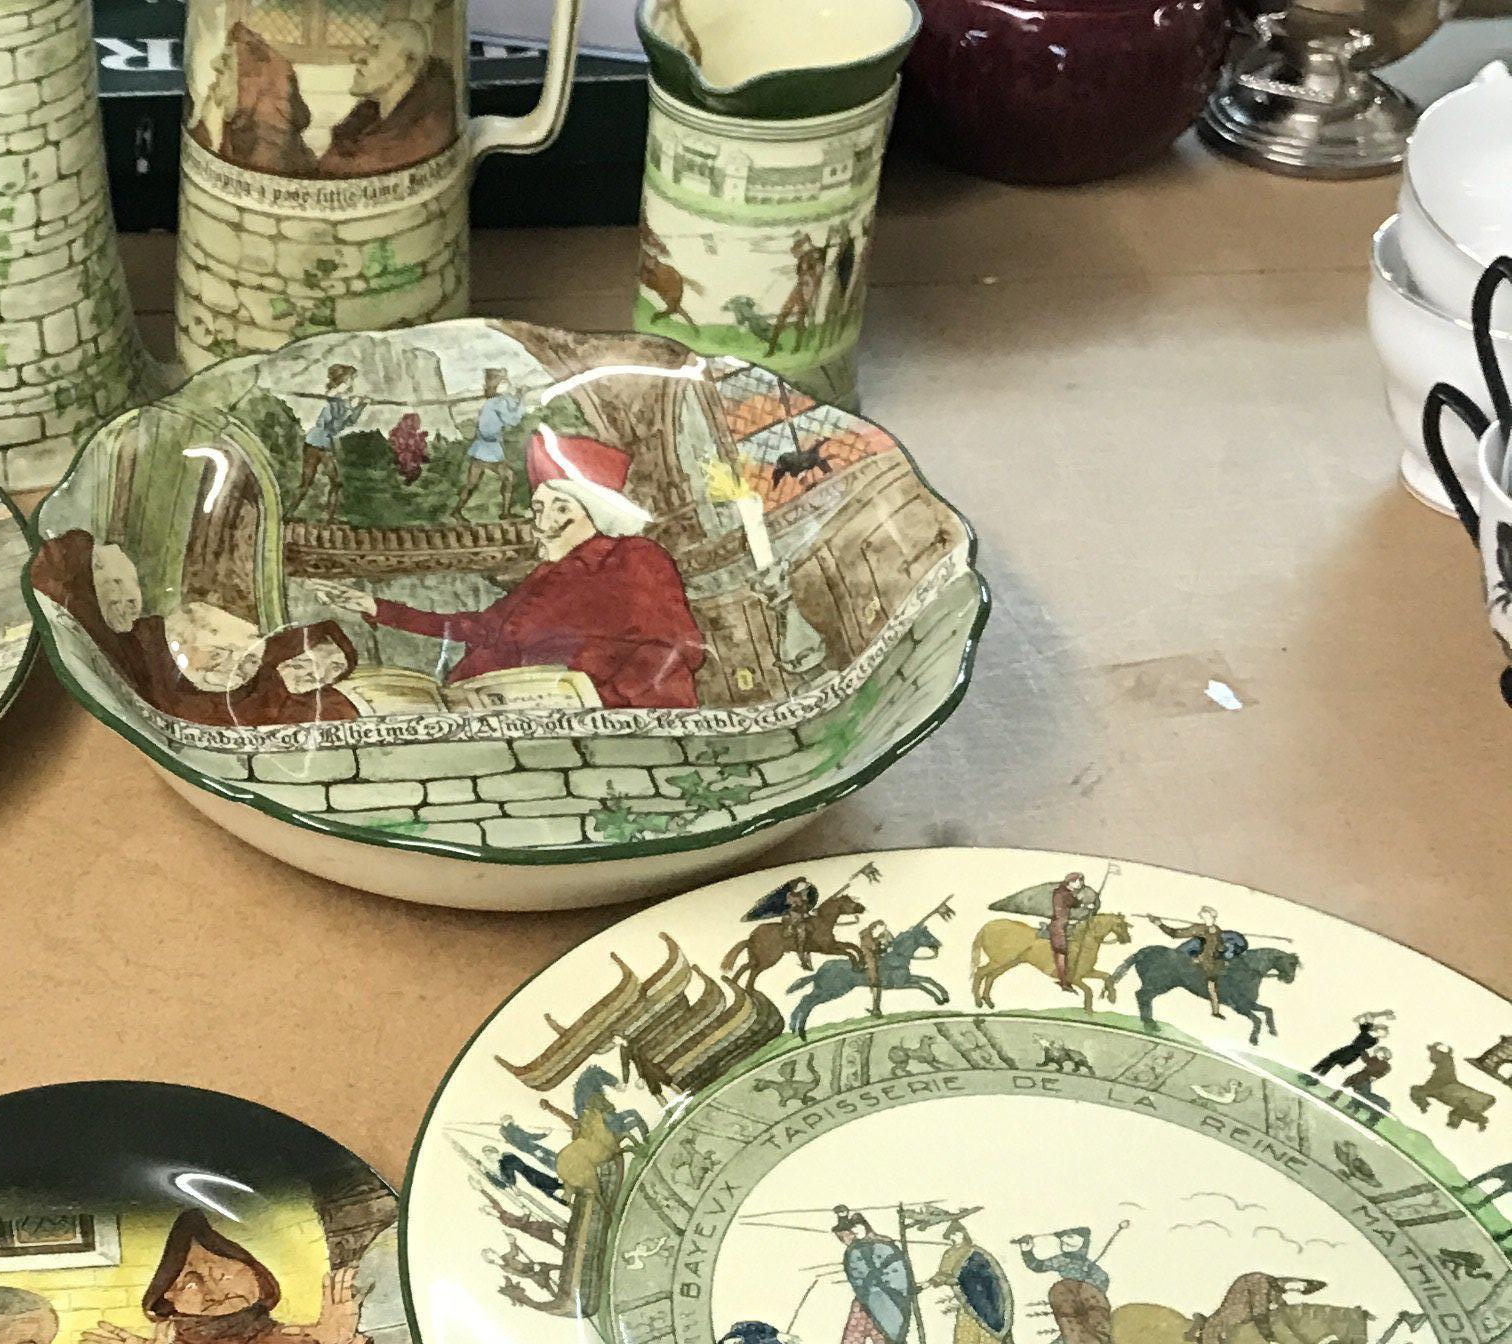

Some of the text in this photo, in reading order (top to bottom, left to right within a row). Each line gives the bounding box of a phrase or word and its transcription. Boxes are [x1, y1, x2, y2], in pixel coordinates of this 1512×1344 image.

[591, 714, 642, 732] that
[656, 712, 746, 731] terrible
[759, 1075, 965, 1151] TAPISSERIE
[1012, 1075, 1062, 1093] DE
[1107, 1087, 1157, 1111] LA
[1200, 1116, 1308, 1175] REINE
